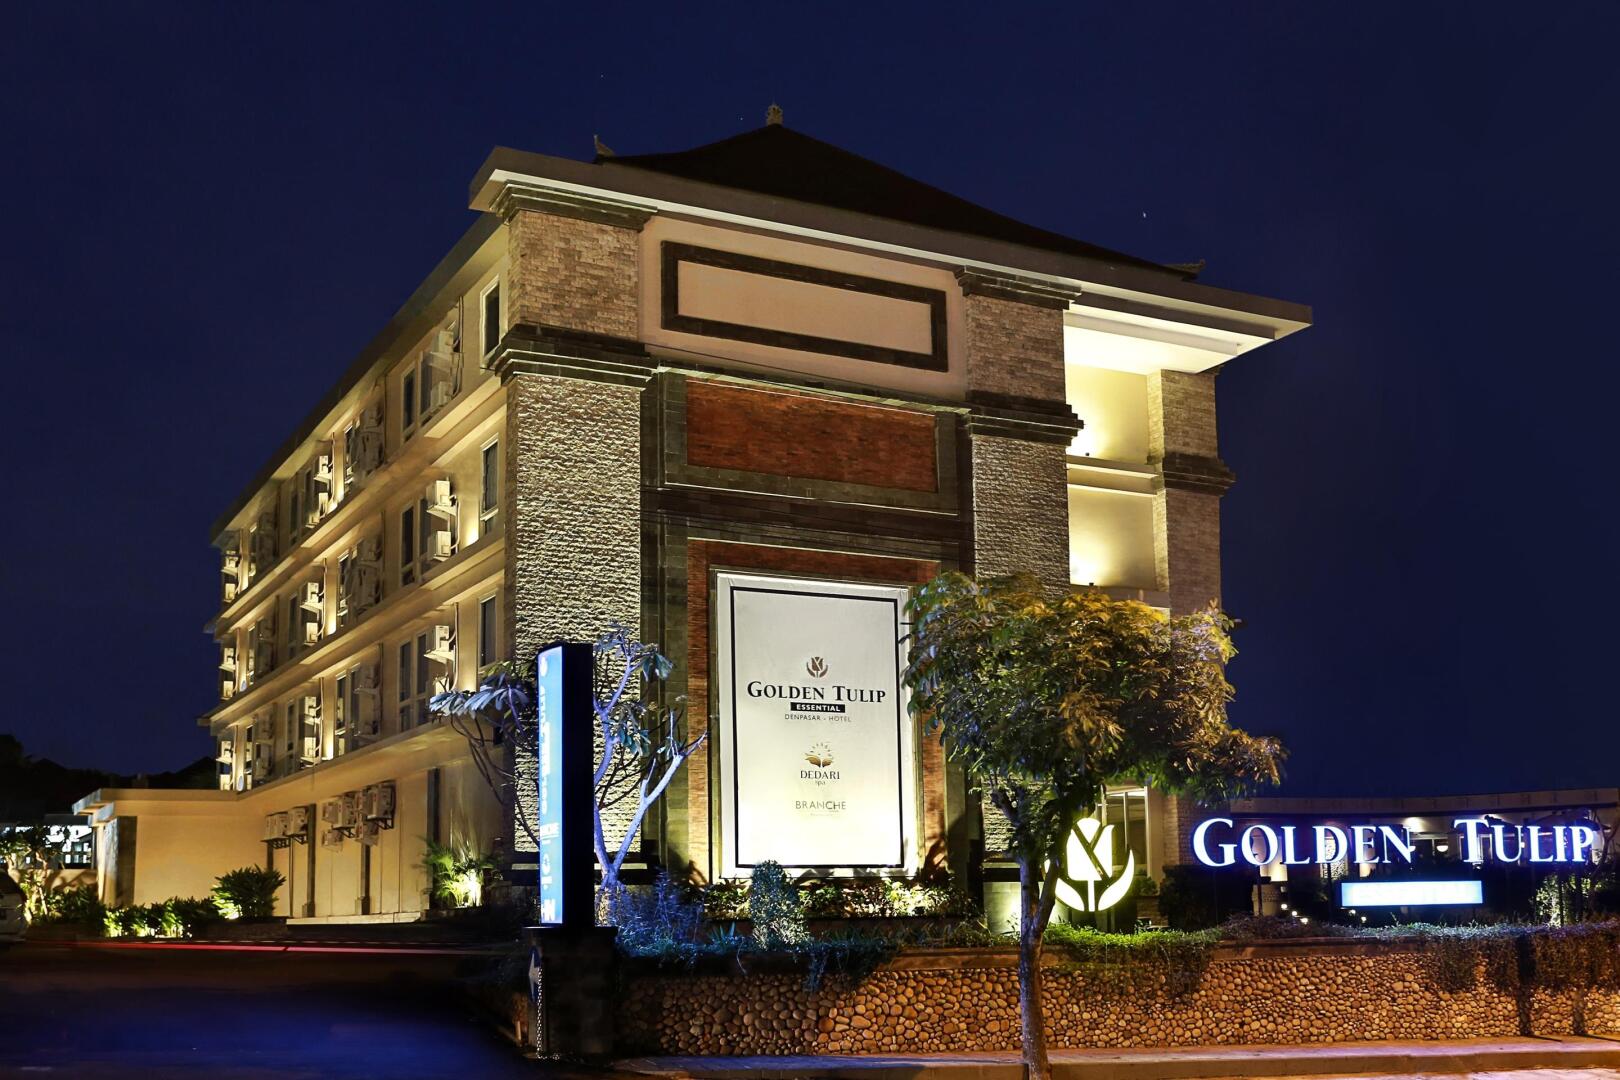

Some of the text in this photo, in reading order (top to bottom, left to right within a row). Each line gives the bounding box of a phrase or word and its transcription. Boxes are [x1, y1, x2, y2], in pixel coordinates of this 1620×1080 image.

[747, 681, 886, 703] GOLDEN TULIP
[796, 703, 841, 712] ESSENTIAL
[800, 770, 841, 780] DEDARI
[795, 800, 847, 810] BRANCHE
[1192, 817, 1595, 867] GOLDEN TULIP
